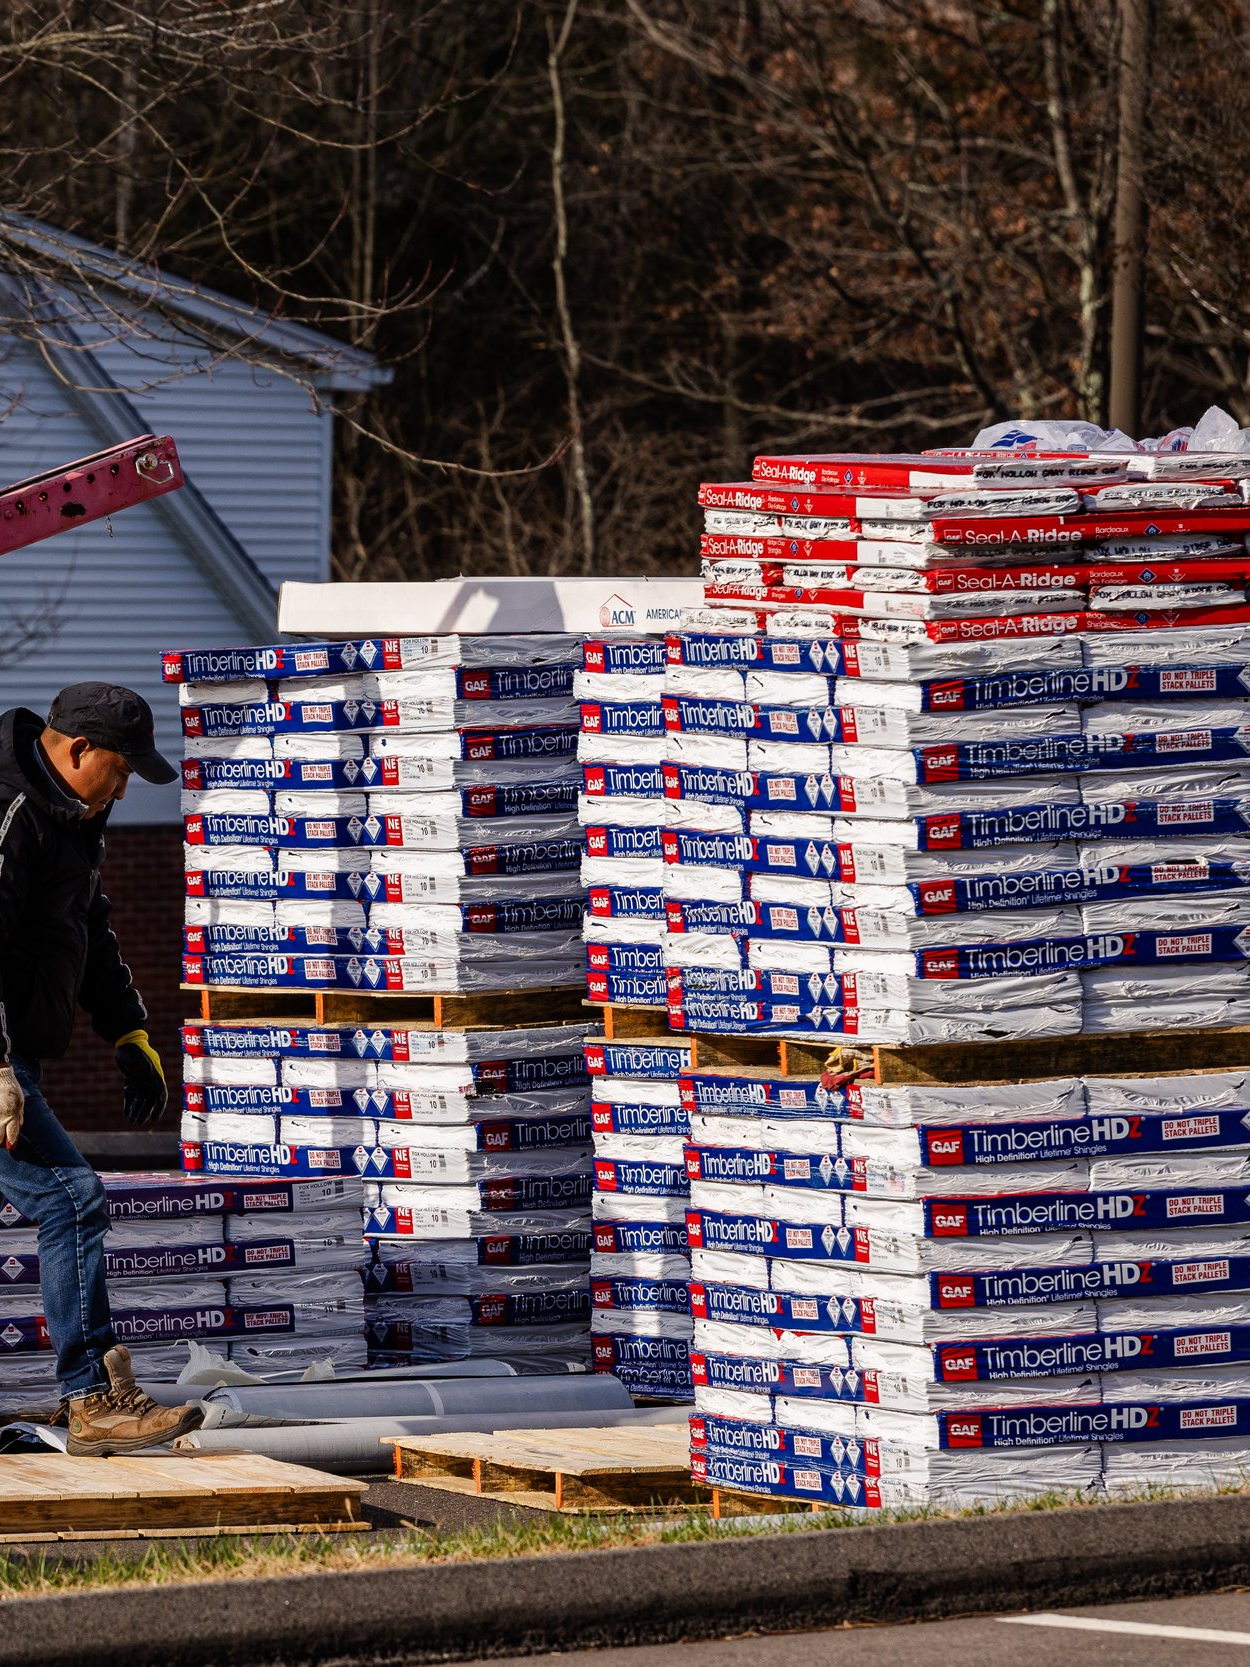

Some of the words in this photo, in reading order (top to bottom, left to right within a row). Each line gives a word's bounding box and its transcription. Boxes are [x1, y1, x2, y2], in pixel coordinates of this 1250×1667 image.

[761, 462, 816, 483] Seal-A-Ridge
[706, 489, 763, 508] Seal-A-Ridge
[965, 528, 1083, 545] Seal-A-Ridge
[708, 537, 764, 558] Seal-A-Ridge
[957, 573, 1076, 589] Seal-A-Ridge
[612, 611, 635, 624] ACM
[646, 609, 681, 619] AMERICA
[960, 616, 1078, 638] Seal-A-Ridge
[385, 641, 398, 653] NE
[421, 645, 429, 654] 10
[667, 646, 681, 660] GAF
[683, 634, 764, 661] TimberlineHDZ
[844, 643, 857, 662] NE
[186, 649, 284, 671] TimberlineHDZ
[586, 652, 603, 664] GAF
[165, 664, 181, 675] GAF
[1162, 673, 1172, 681] DO
[1174, 672, 1187, 680] NOT
[1190, 671, 1215, 679] TRIPLE
[465, 680, 488, 691] GAF
[974, 666, 1140, 700] TimberlineHDZ
[1162, 680, 1184, 690] STACK
[1186, 679, 1214, 689] PALLETS
[933, 691, 962, 704] GAF
[202, 703, 293, 725] TimberlineHDZ
[665, 709, 679, 722] GAF
[680, 702, 761, 728] TimberlineHDZ
[185, 716, 199, 727] GAF
[965, 734, 1135, 764] TimberlineHDZ
[927, 755, 956, 768] GAF
[665, 775, 679, 788] GAF
[681, 769, 759, 796] TimberlineHDZ
[205, 815, 297, 836] TimberlineHDZ
[388, 818, 400, 830] NE
[968, 803, 1138, 836] TimberlineHDZ
[187, 823, 201, 833] GAF
[421, 827, 429, 836] 10
[930, 825, 958, 839] GAF
[209, 835, 220, 845] High
[221, 834, 240, 844] Definition
[260, 835, 278, 845] Shingles
[664, 843, 678, 856] GAF
[680, 835, 759, 861] TimberlineHDZ
[840, 850, 852, 864] NE
[962, 866, 1132, 899] TimberlineHDZ
[924, 889, 953, 903] GAF
[968, 901, 987, 911] High
[989, 897, 1027, 907] Definition
[1032, 895, 1062, 904] Lifetime
[1064, 889, 1098, 902] Shingles
[1158, 938, 1168, 947] DO
[1171, 937, 1184, 946] NOT
[1187, 935, 1210, 945] TRIPLE
[965, 934, 1136, 969] TimberlineHDZ
[1158, 945, 1180, 954] STACK
[1181, 943, 1210, 952] PALLETS
[205, 957, 295, 975] TimberlineHDZ
[204, 1030, 299, 1048] TimberlineHDZ
[394, 1032, 406, 1044] NE
[588, 1056, 604, 1068] GAF
[594, 1113, 611, 1124] GAF
[1164, 1121, 1173, 1129] DO
[1176, 1120, 1190, 1128] NOT
[1193, 1117, 1217, 1127] TRIPLE
[969, 1117, 1143, 1153] TimberlineHDZ
[1164, 1128, 1187, 1137] STACK
[1189, 1125, 1218, 1136] PALLETS
[485, 1132, 509, 1145] GAF
[204, 1143, 298, 1164] TimberlineHDZ
[931, 1141, 960, 1153] GAF
[395, 1149, 408, 1161] NE
[975, 1154, 996, 1164] High
[997, 1152, 1035, 1161] Definition
[1040, 1148, 1071, 1159] Lifetime
[1074, 1144, 1107, 1155] Shingles
[429, 1160, 437, 1168] 10
[688, 1161, 700, 1173] GAF
[702, 1153, 777, 1176] TimberlineHDZ
[310, 1181, 333, 1189] HOLLOW
[321, 1188, 332, 1196] 10
[107, 1192, 233, 1215] imberlineHDZ
[974, 1195, 1146, 1226] TimberlineHDZ
[935, 1215, 964, 1228] GAF
[688, 1223, 700, 1236] GAF
[703, 1216, 778, 1243] TimberlineHDZ
[856, 1230, 868, 1243] NE
[104, 1246, 235, 1270] TimberlineHDZ
[981, 1262, 1153, 1297] TimberlineHDZ
[595, 1291, 611, 1302] GAF
[942, 1286, 971, 1298] GAF
[324, 1305, 333, 1313] 10
[110, 1310, 235, 1333] imberlineHDZ
[983, 1336, 1154, 1369] TimberlineHDZ
[708, 1357, 785, 1383] TimberlineHDZ
[945, 1358, 974, 1370] GAF
[1182, 1411, 1192, 1419] DO
[1195, 1410, 1207, 1418] NOT
[1211, 1408, 1235, 1417] TRIPLE
[989, 1408, 1159, 1436] TimberlineHDZ
[1182, 1419, 1204, 1427] STACK
[1206, 1416, 1235, 1426] PALLETS
[950, 1424, 979, 1436] GAF
[867, 1442, 878, 1454] NE
[896, 1458, 902, 1468] 10
